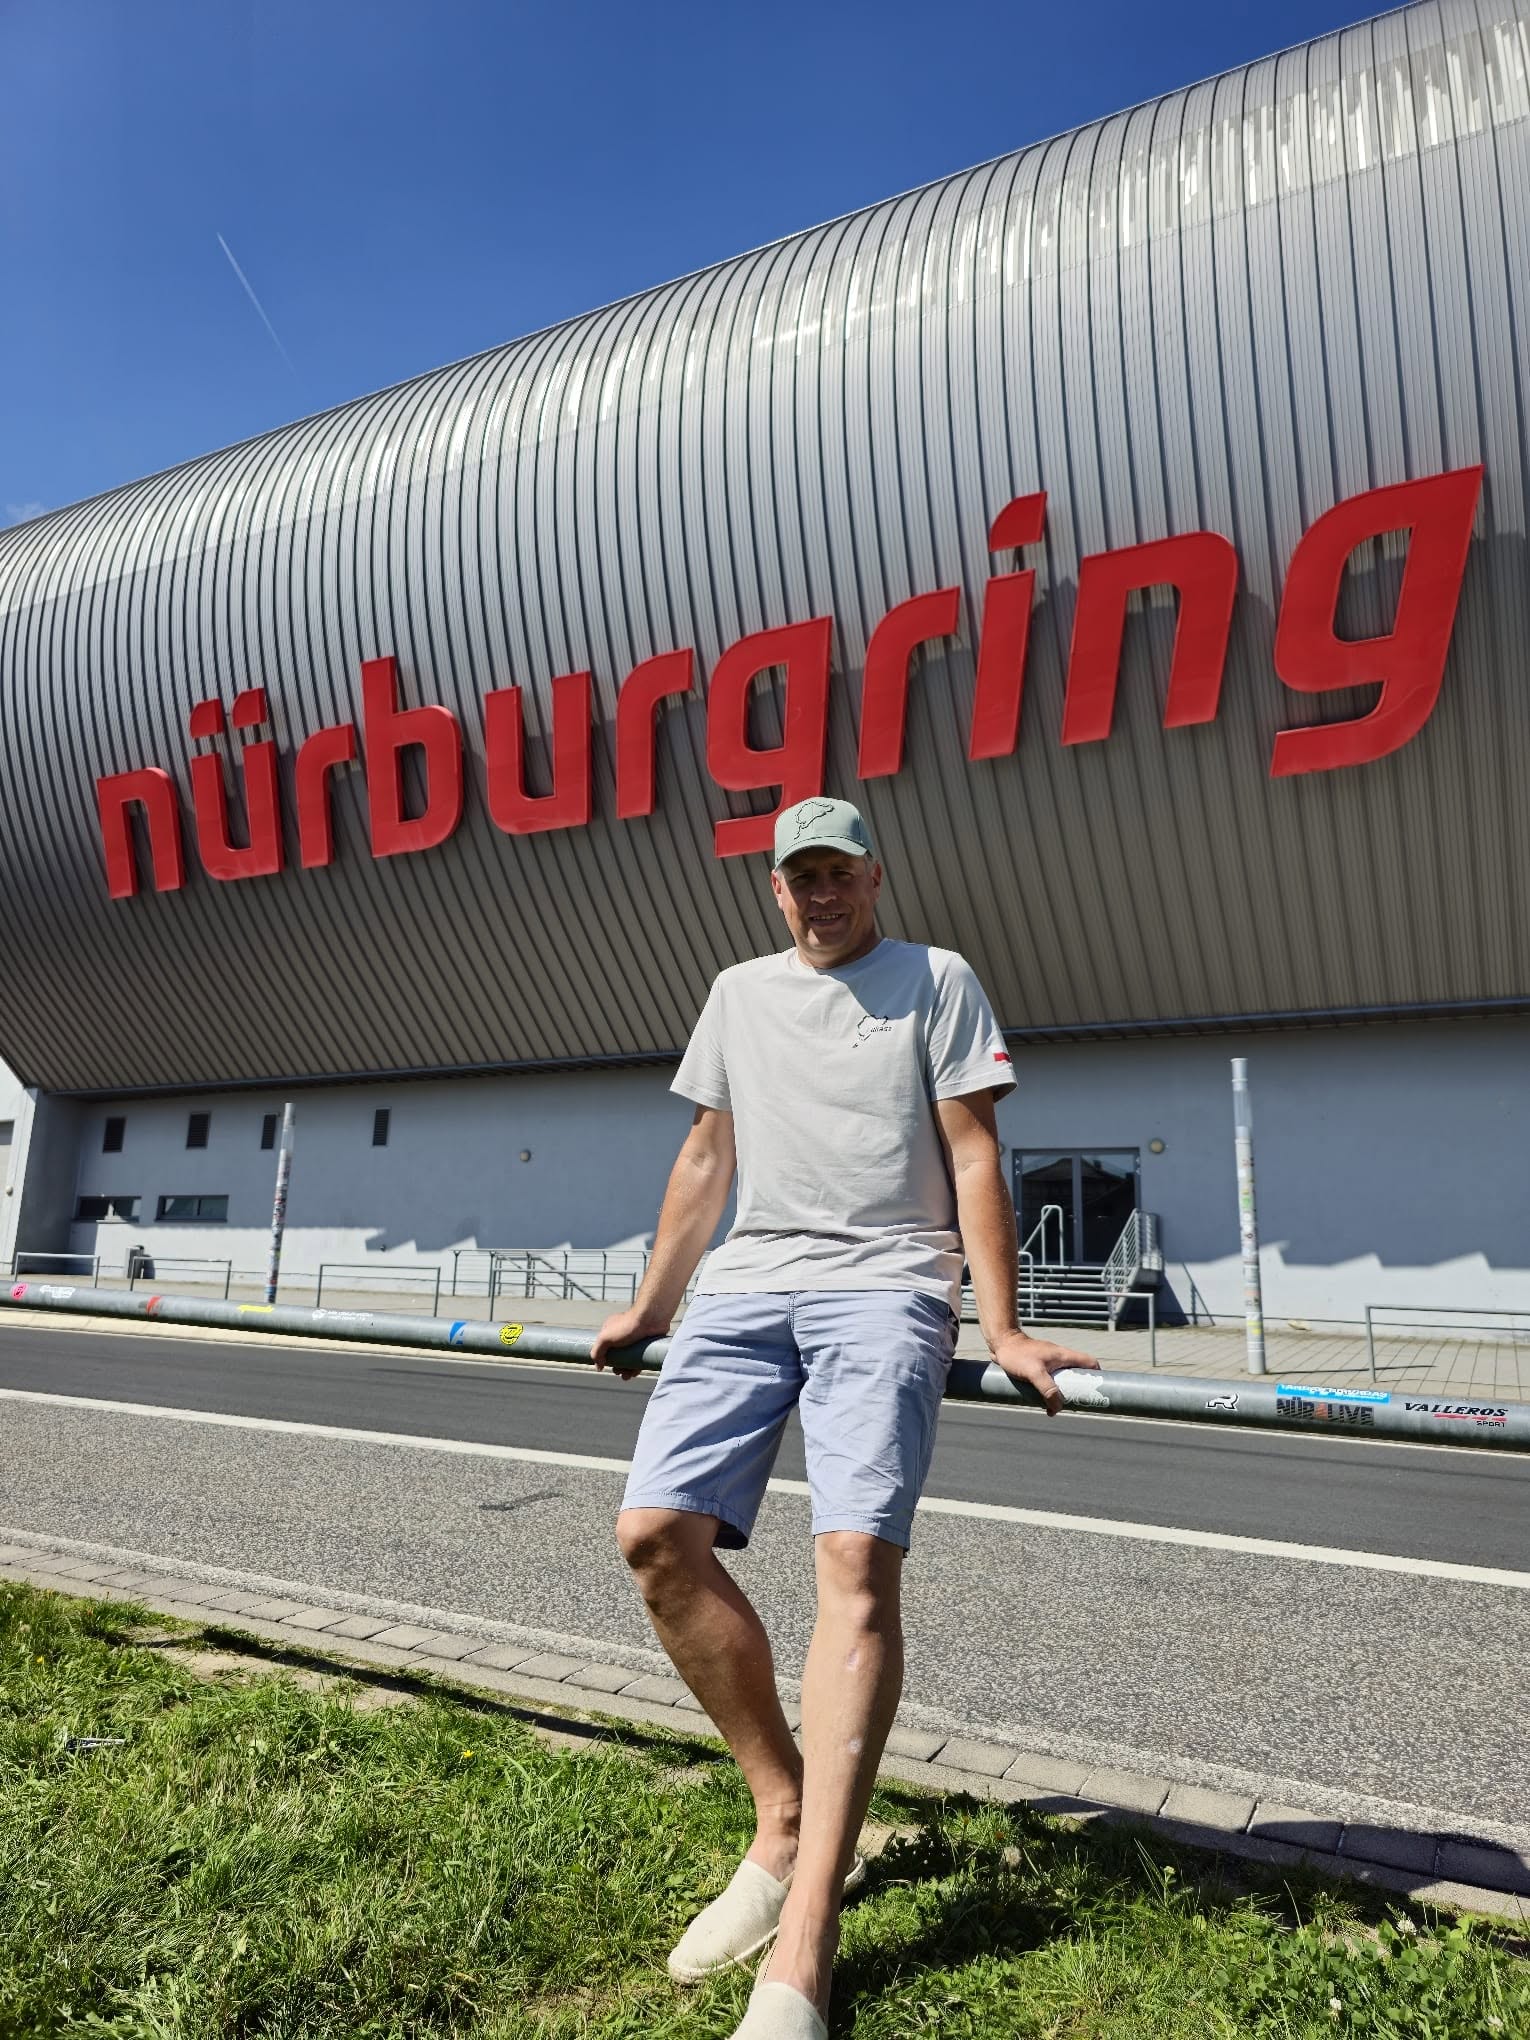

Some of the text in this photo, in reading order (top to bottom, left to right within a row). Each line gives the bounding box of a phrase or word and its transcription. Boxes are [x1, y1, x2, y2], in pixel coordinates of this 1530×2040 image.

[97, 464, 1485, 898] nürburgring
[1404, 1402, 1509, 1417] VALLEROS
[1476, 1420, 1506, 1428] SPORT
